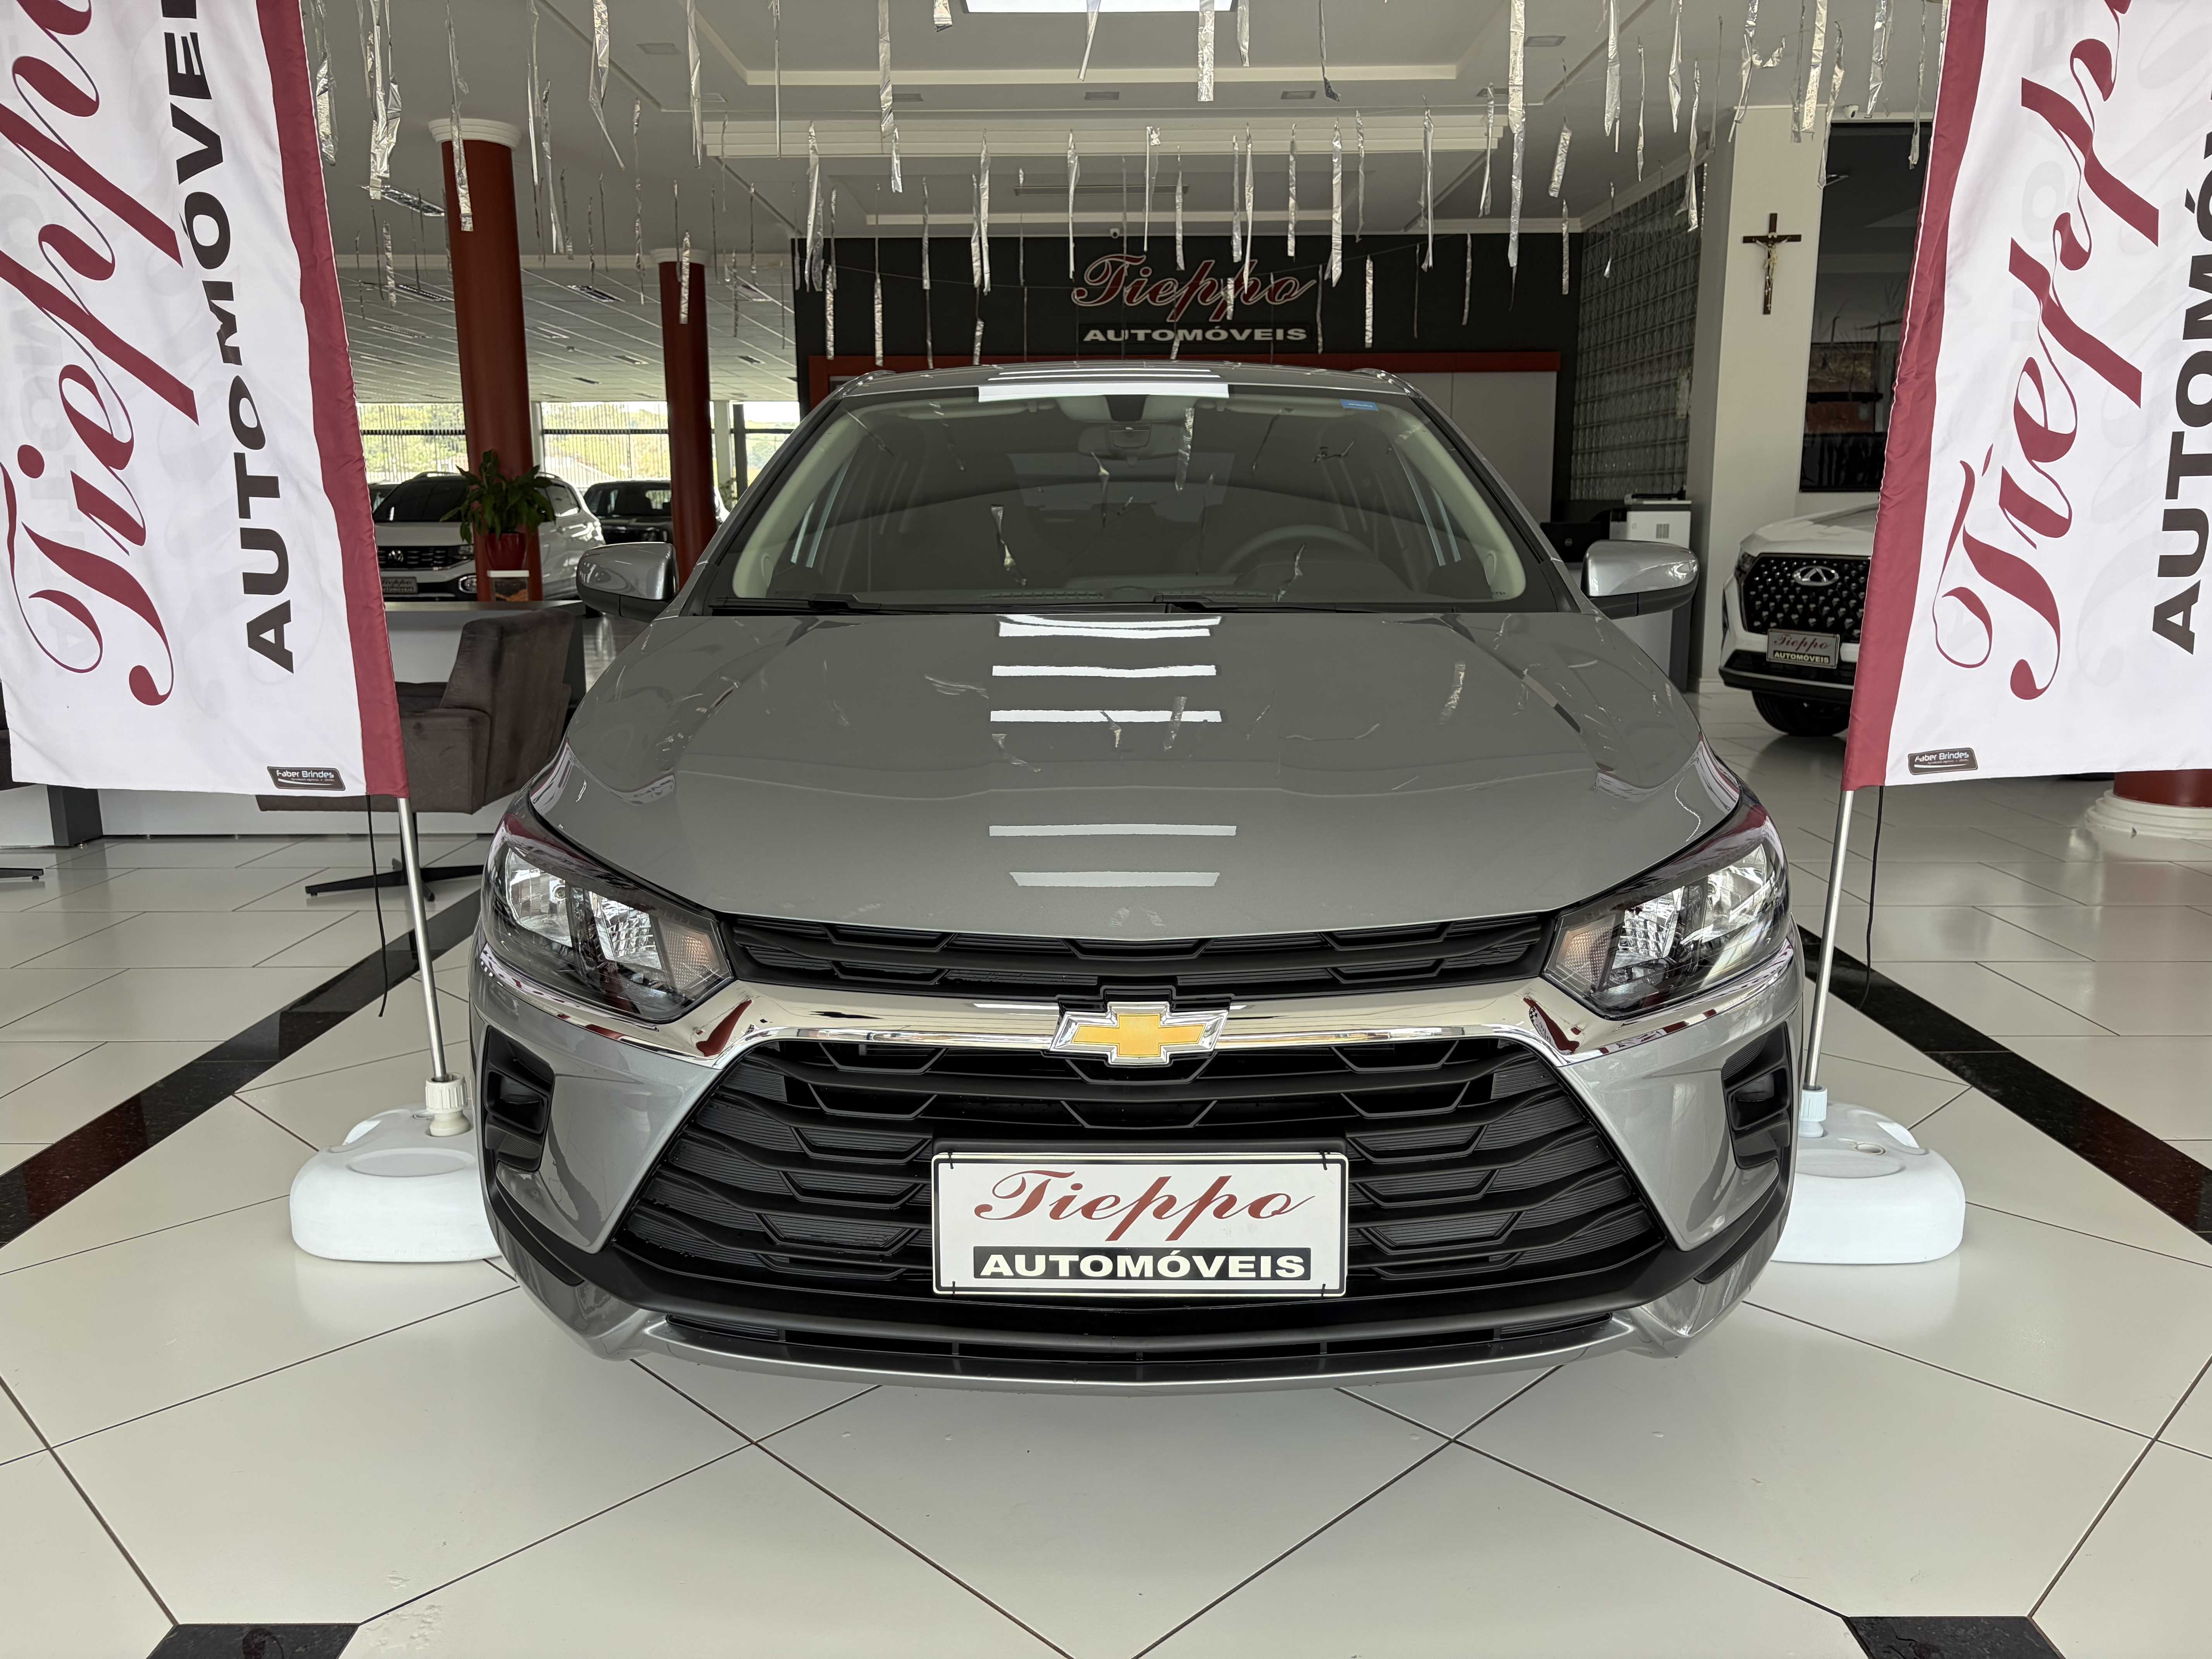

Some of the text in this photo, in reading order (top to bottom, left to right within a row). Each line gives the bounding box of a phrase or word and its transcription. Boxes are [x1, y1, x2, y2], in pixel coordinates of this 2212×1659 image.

[1071, 254, 1316, 322] Tieppo
[1083, 326, 1307, 342] AUTOMÓVEIS
[1932, 0, 2159, 700] Tiepp
[1774, 634, 1829, 652] Tieppo
[1774, 651, 1829, 663] AUTOMÓVEIS
[1915, 754, 1937, 762] Faber
[1939, 751, 1969, 760] Brindes
[974, 1170, 1315, 1241] Tieppo
[980, 1250, 1305, 1278] AUTOMÓVEIS
